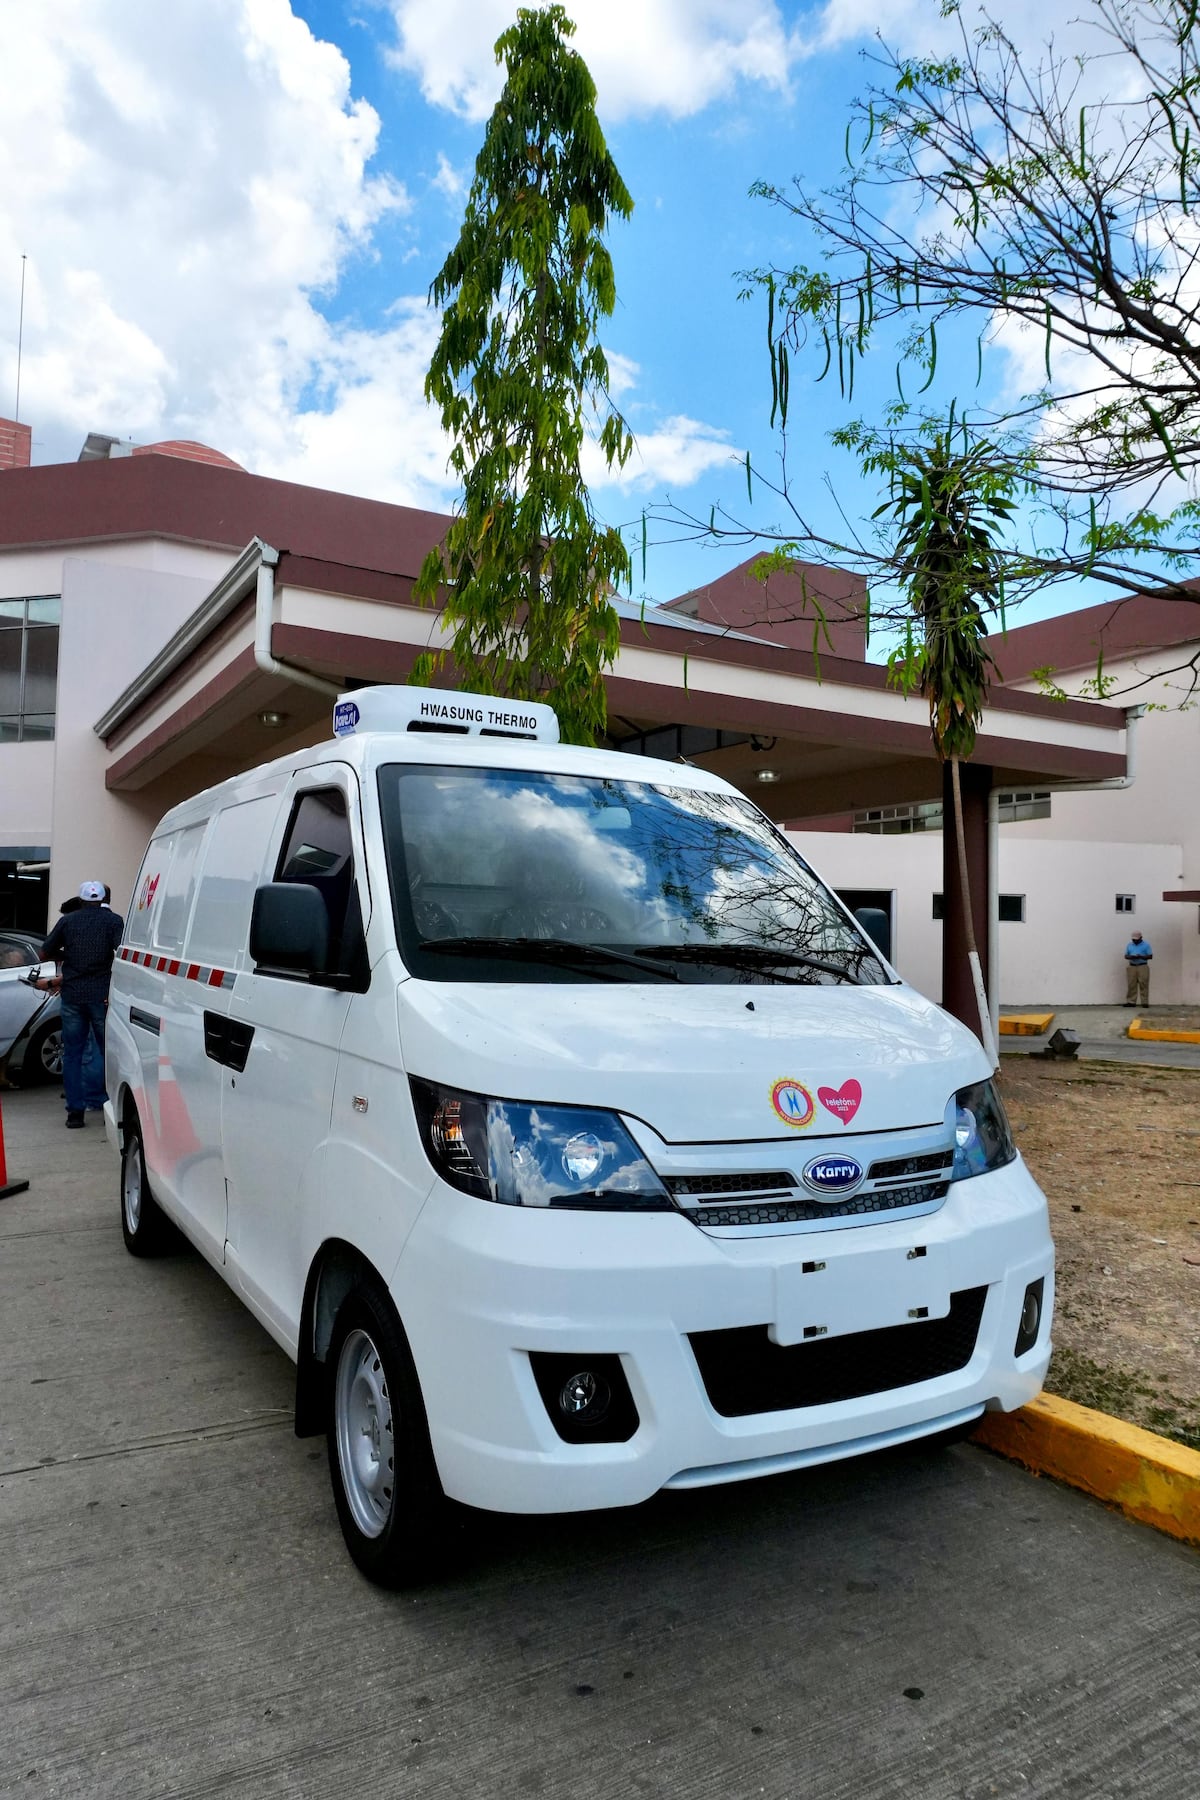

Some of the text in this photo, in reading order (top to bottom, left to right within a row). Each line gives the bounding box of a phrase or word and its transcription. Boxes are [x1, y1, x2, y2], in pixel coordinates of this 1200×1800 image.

[420, 702, 537, 729] HWASUNG THERMO
[815, 1165, 855, 1179] Karry
